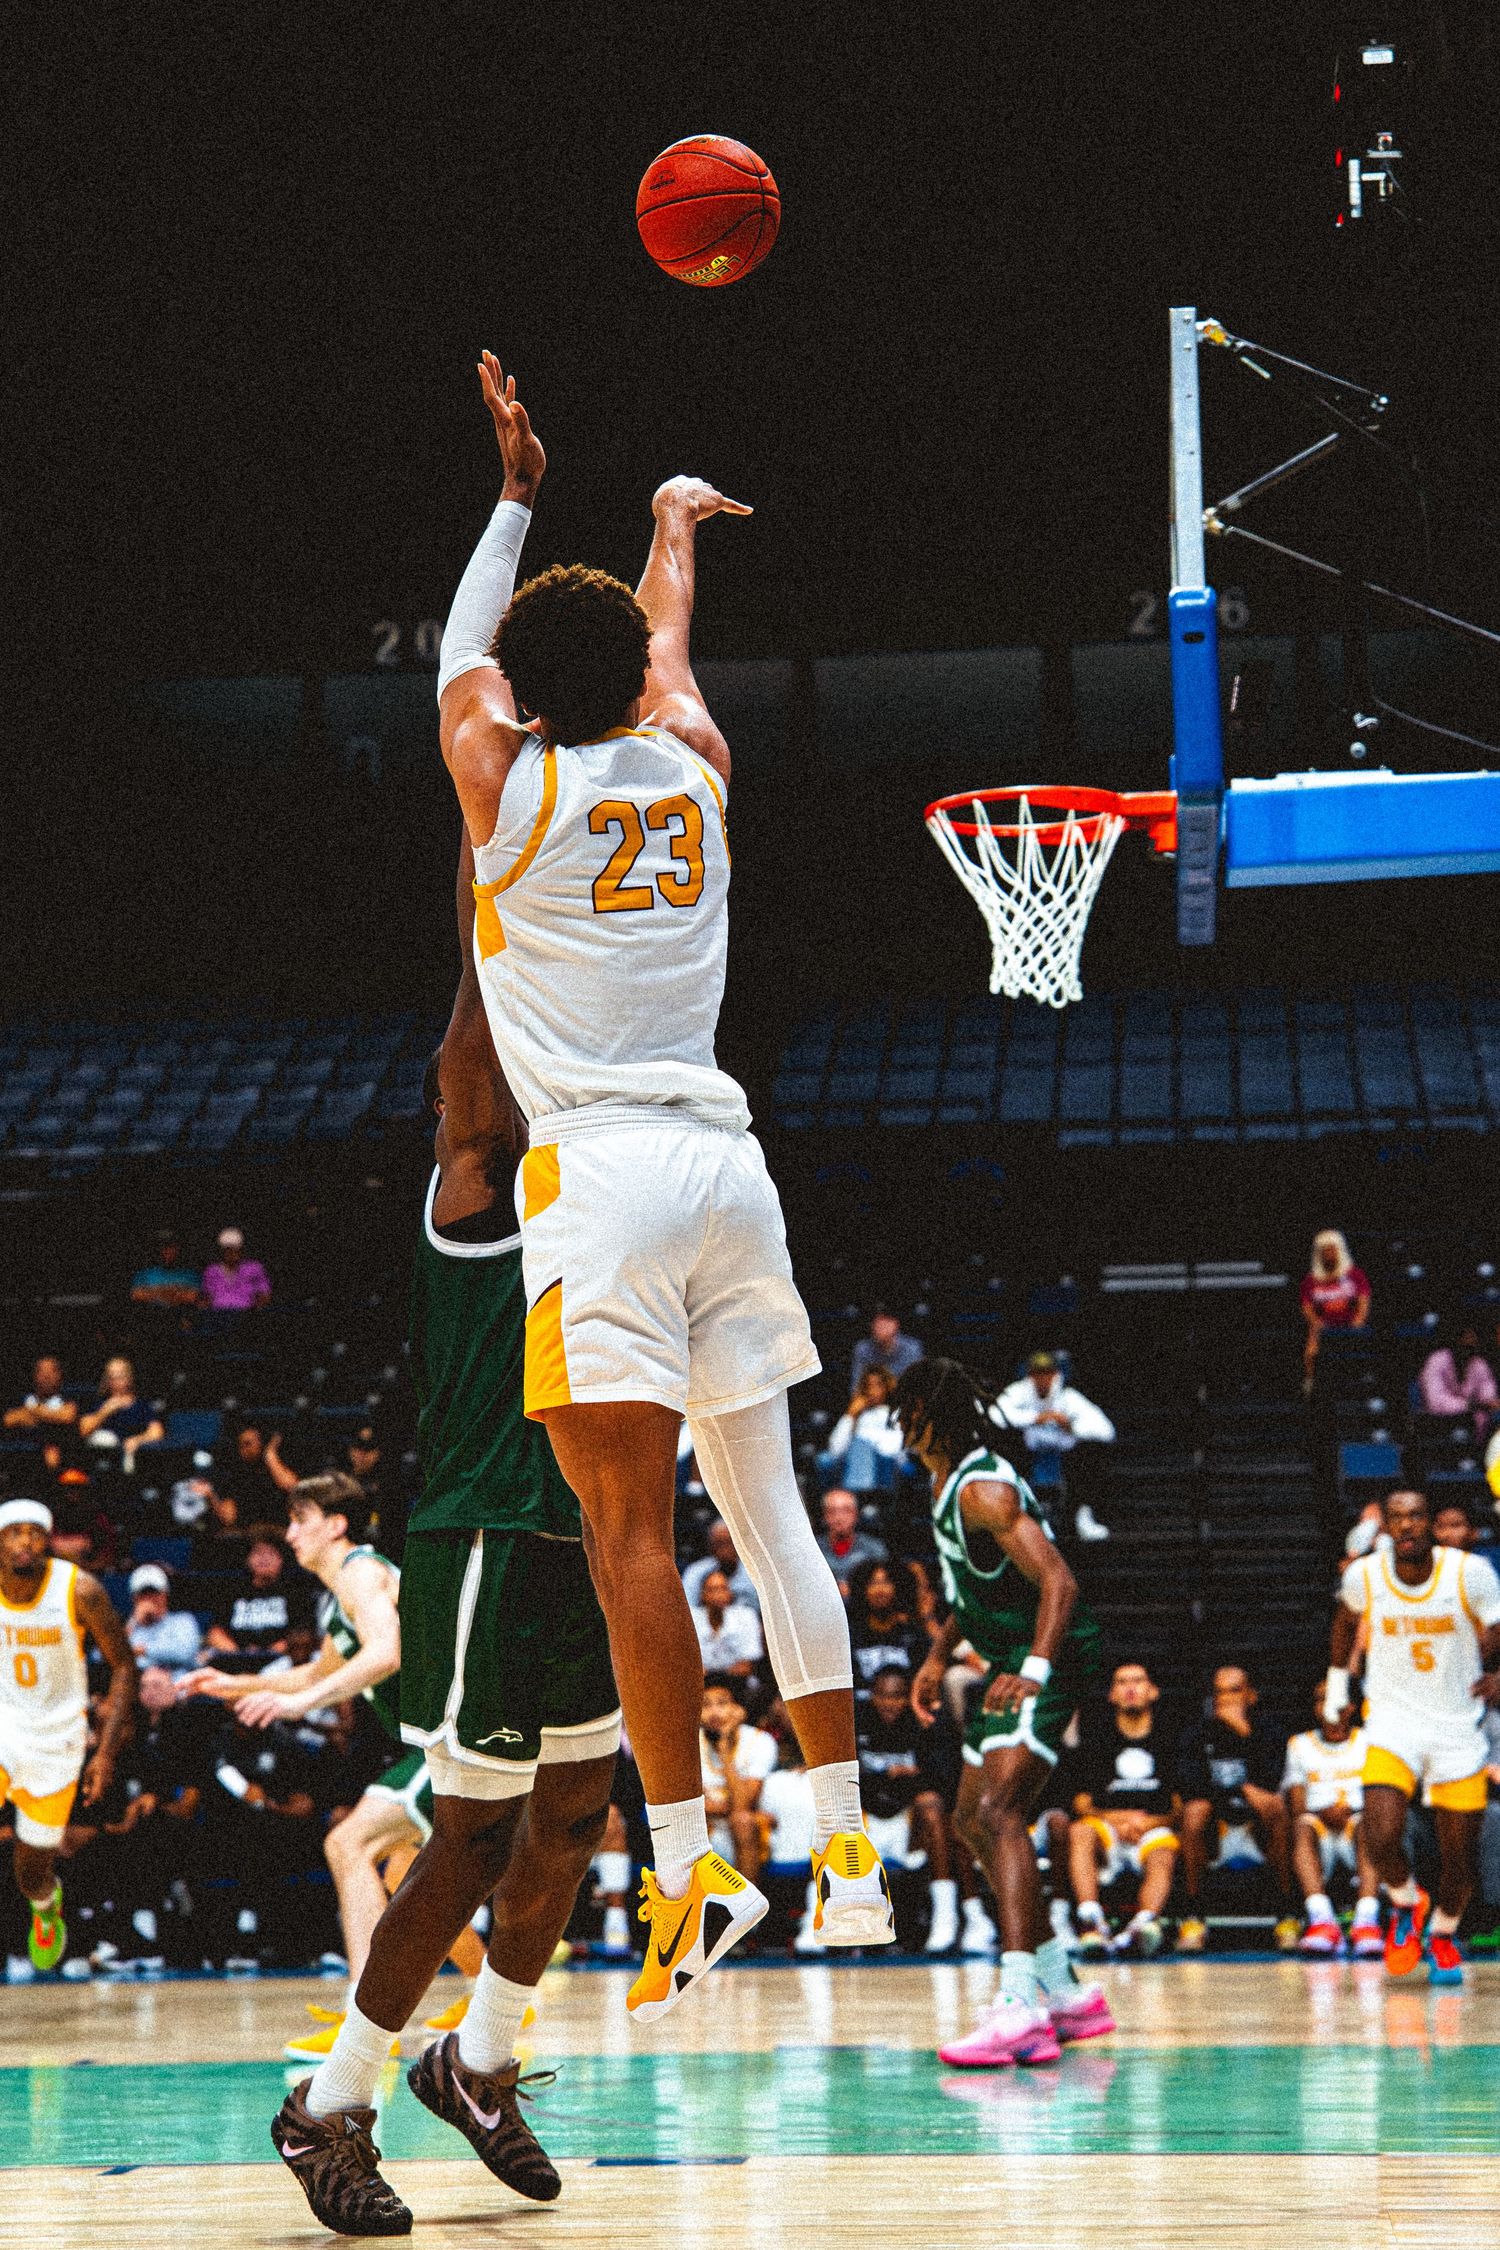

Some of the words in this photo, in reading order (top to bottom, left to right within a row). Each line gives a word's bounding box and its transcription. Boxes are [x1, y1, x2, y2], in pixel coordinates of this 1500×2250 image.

[1128, 586, 1250, 635] 26
[372, 620, 443, 664] 20
[587, 793, 705, 914] 23
[13, 1652, 38, 1689] 0
[1410, 1640, 1436, 1673] 5
